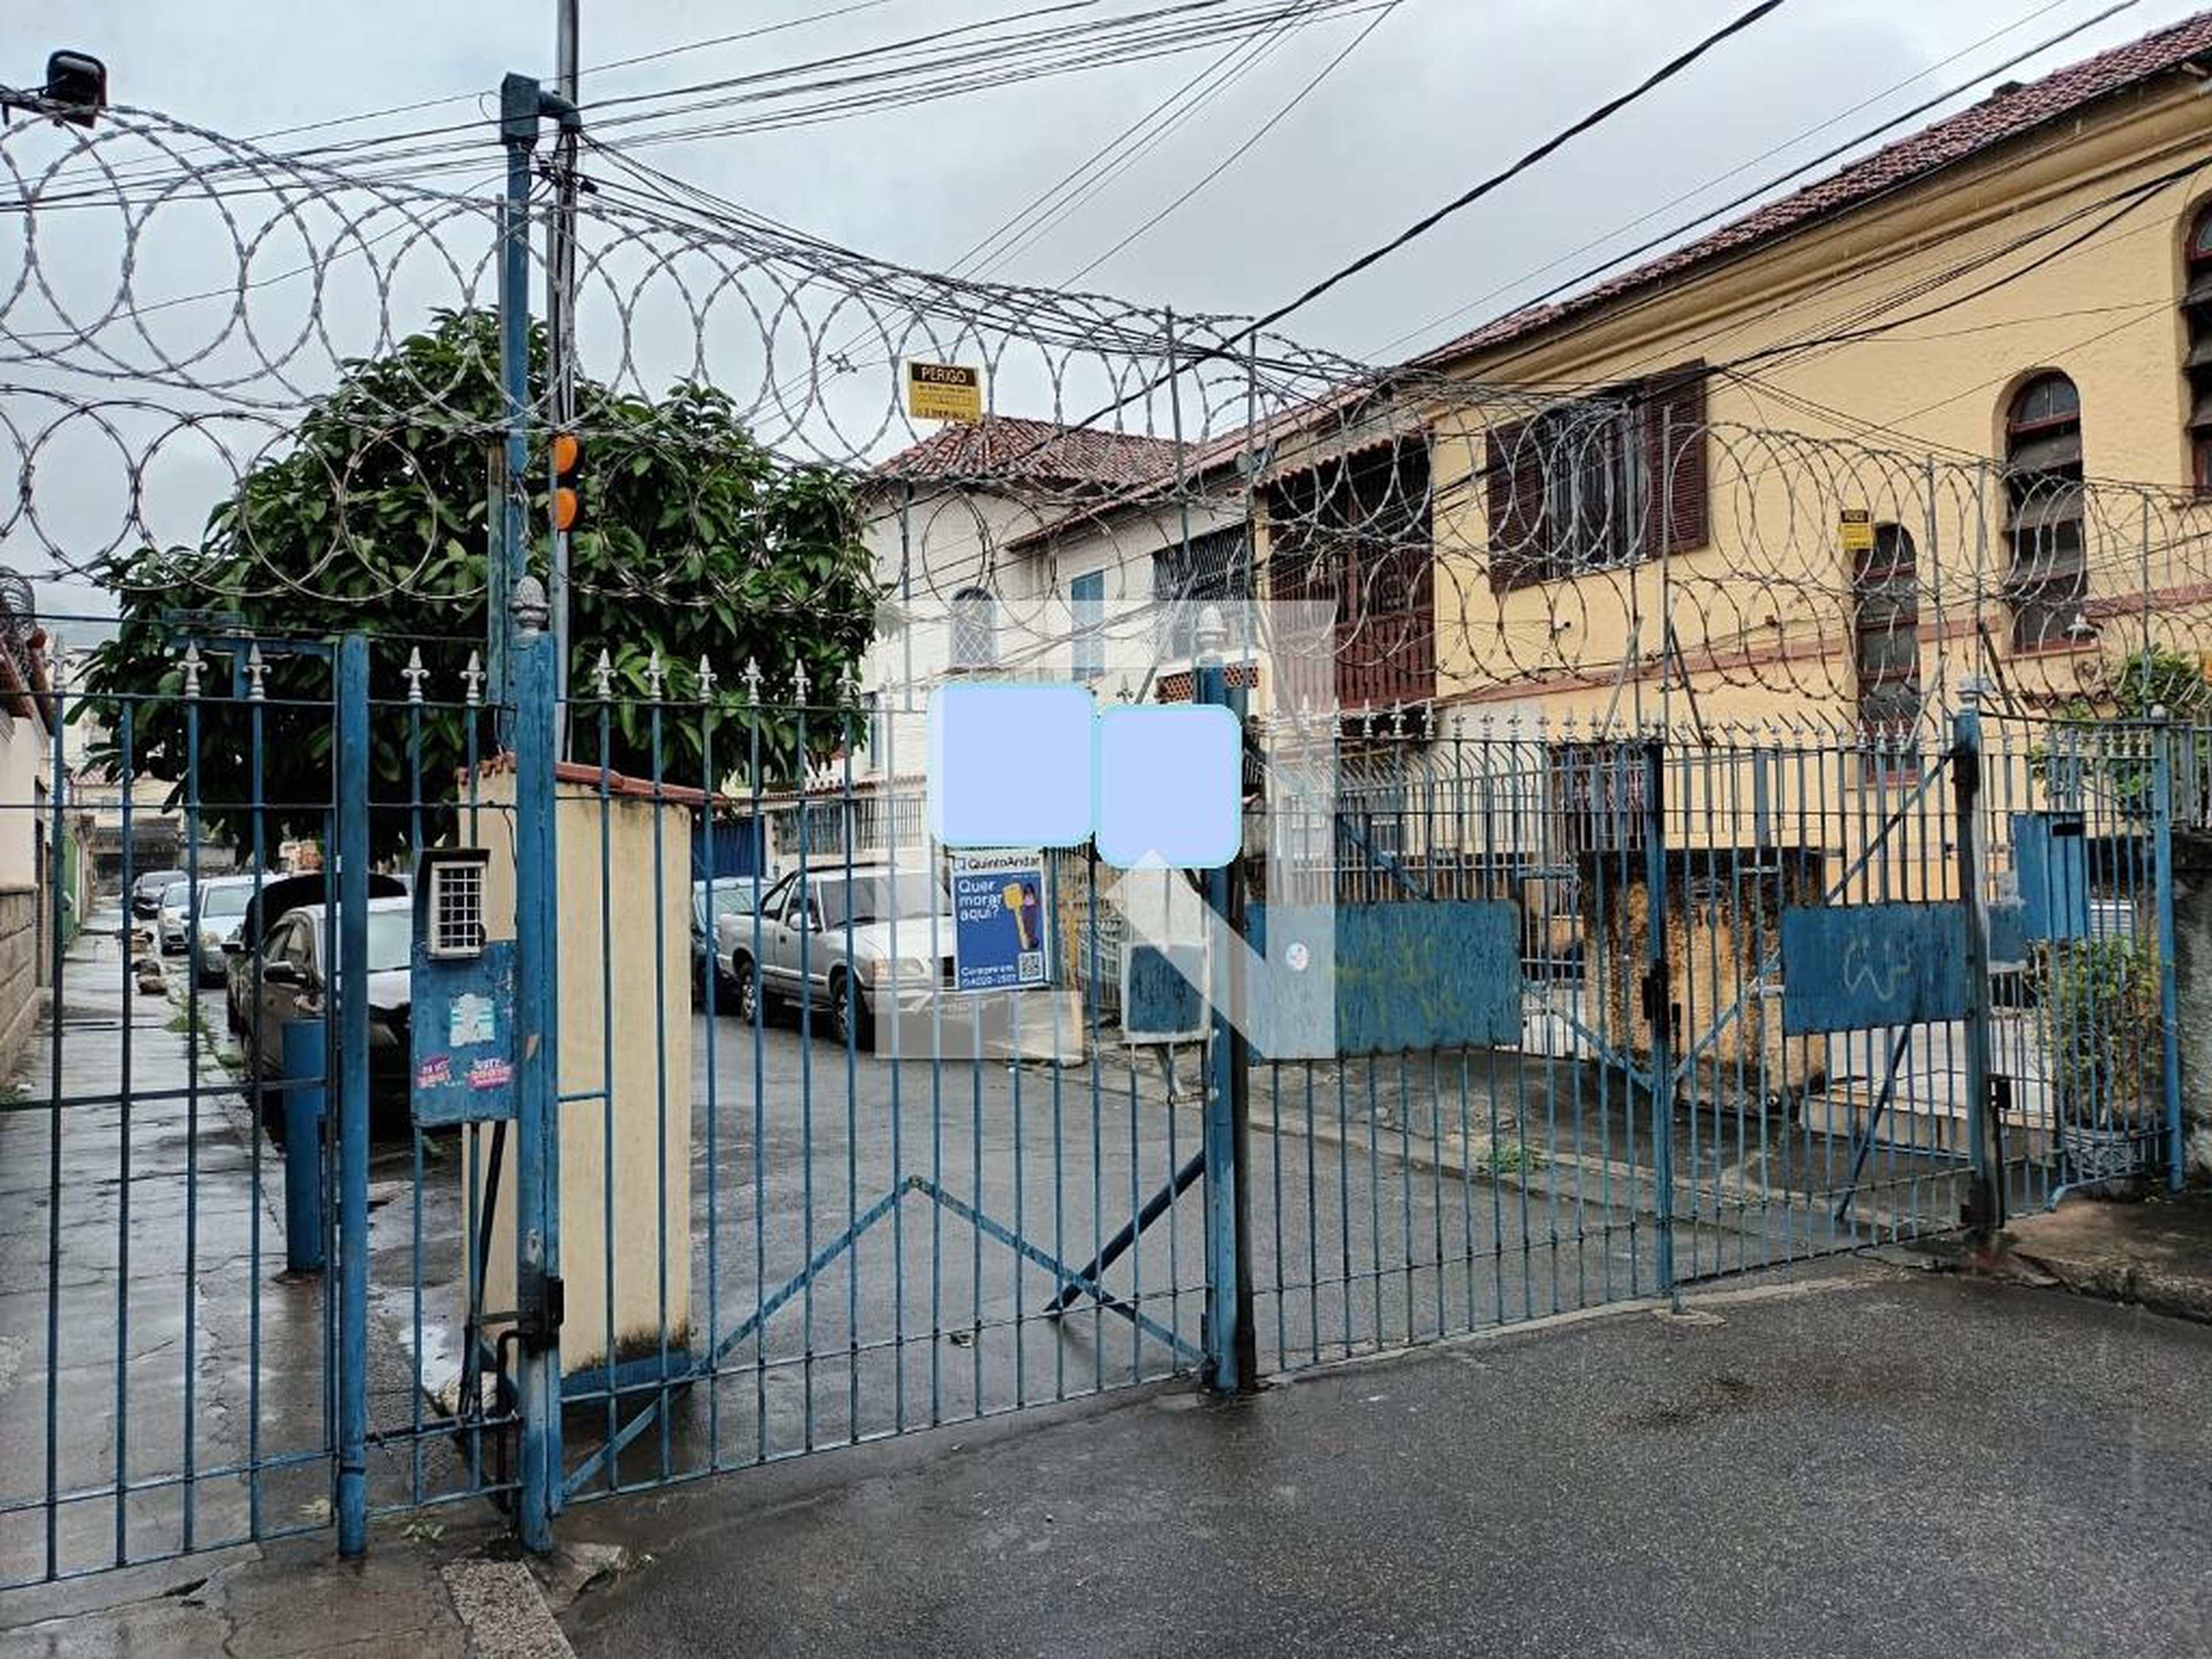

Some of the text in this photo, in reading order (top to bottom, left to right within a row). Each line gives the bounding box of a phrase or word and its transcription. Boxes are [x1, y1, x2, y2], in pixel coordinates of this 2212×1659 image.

[921, 366, 967, 383] PERIGO
[968, 856, 1040, 869] QuintoAndar
[959, 879, 996, 893] Quer
[959, 894, 1002, 907] morar
[960, 904, 999, 922] aqui?
